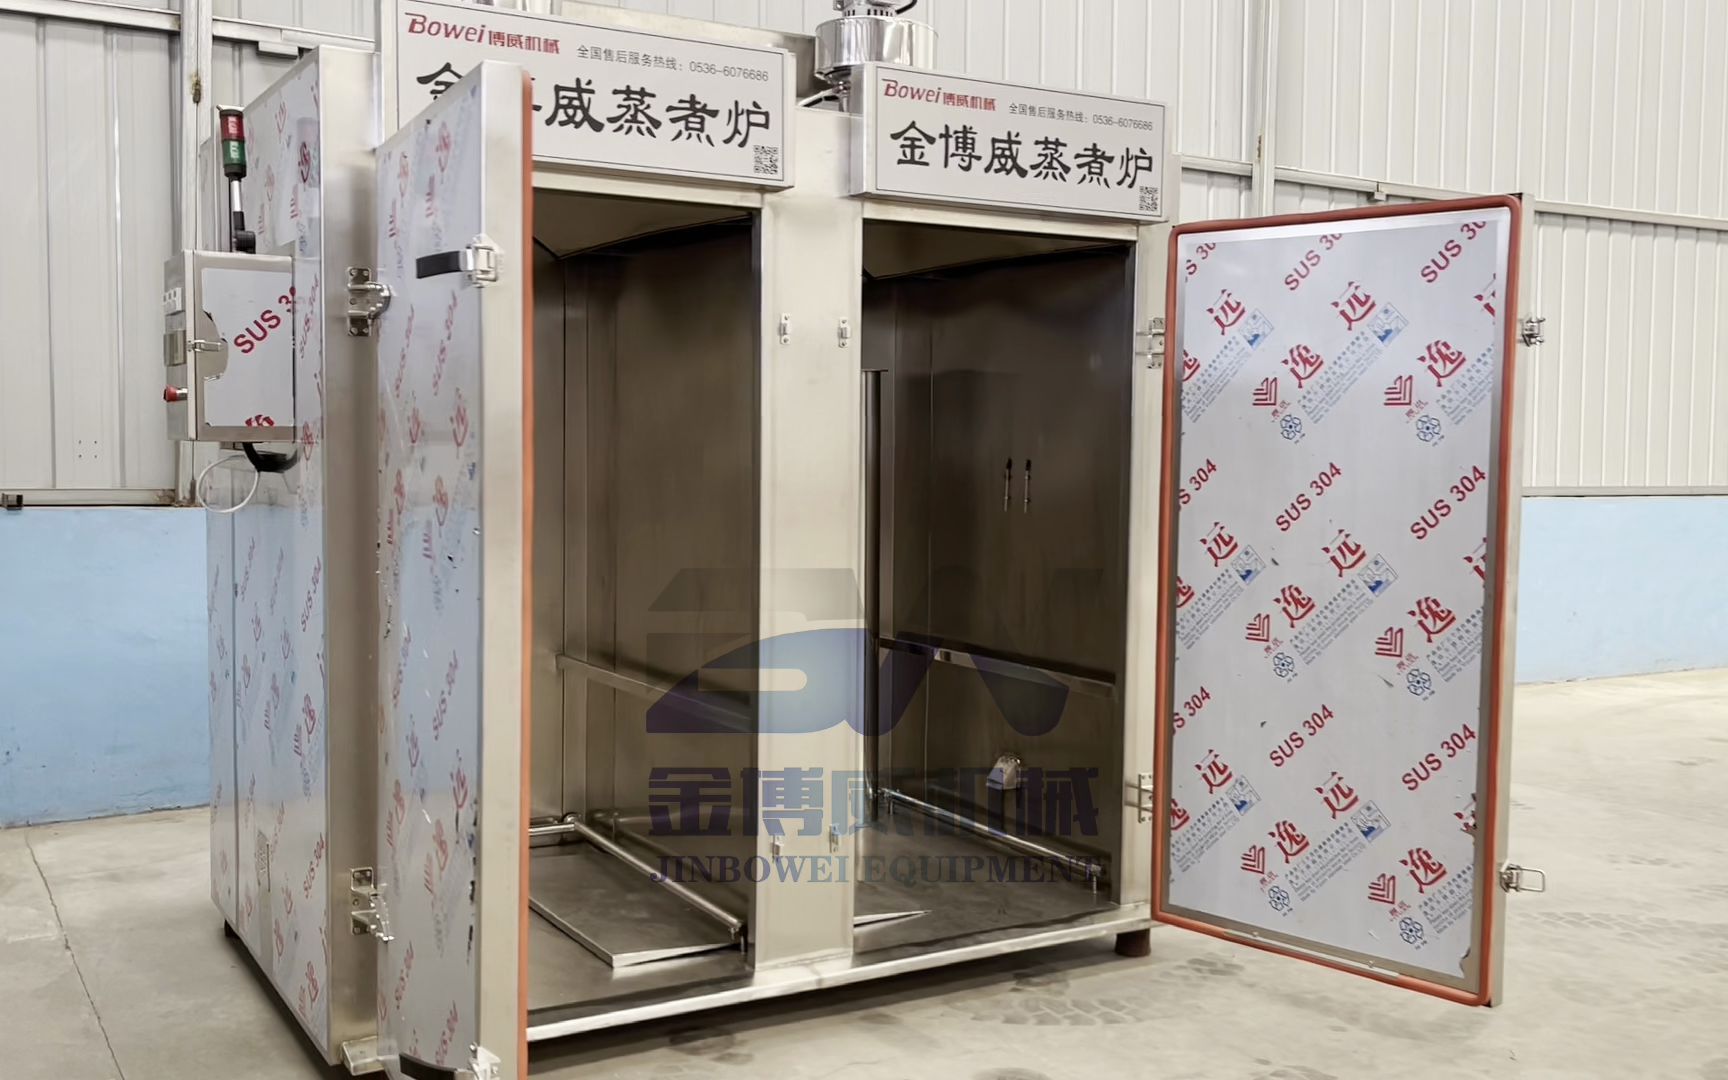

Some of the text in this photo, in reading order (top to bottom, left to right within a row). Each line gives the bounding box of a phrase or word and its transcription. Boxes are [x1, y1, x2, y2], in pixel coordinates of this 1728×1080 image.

[405, 12, 560, 54] Bowei 博威机械
[881, 78, 942, 104] Bowei
[890, 120, 1153, 189] 金博威蒸煮炉
[1284, 249, 1321, 291] SUS
[1420, 239, 1462, 283] SUS
[234, 309, 281, 354] SUS
[1189, 458, 1218, 491] 304
[1275, 493, 1312, 532] SUS
[1309, 462, 1342, 496] 304
[1410, 465, 1486, 540] SUS 304
[1184, 686, 1211, 717] 304
[1269, 704, 1334, 768] SUS 304
[1402, 723, 1476, 791] SUS 304
